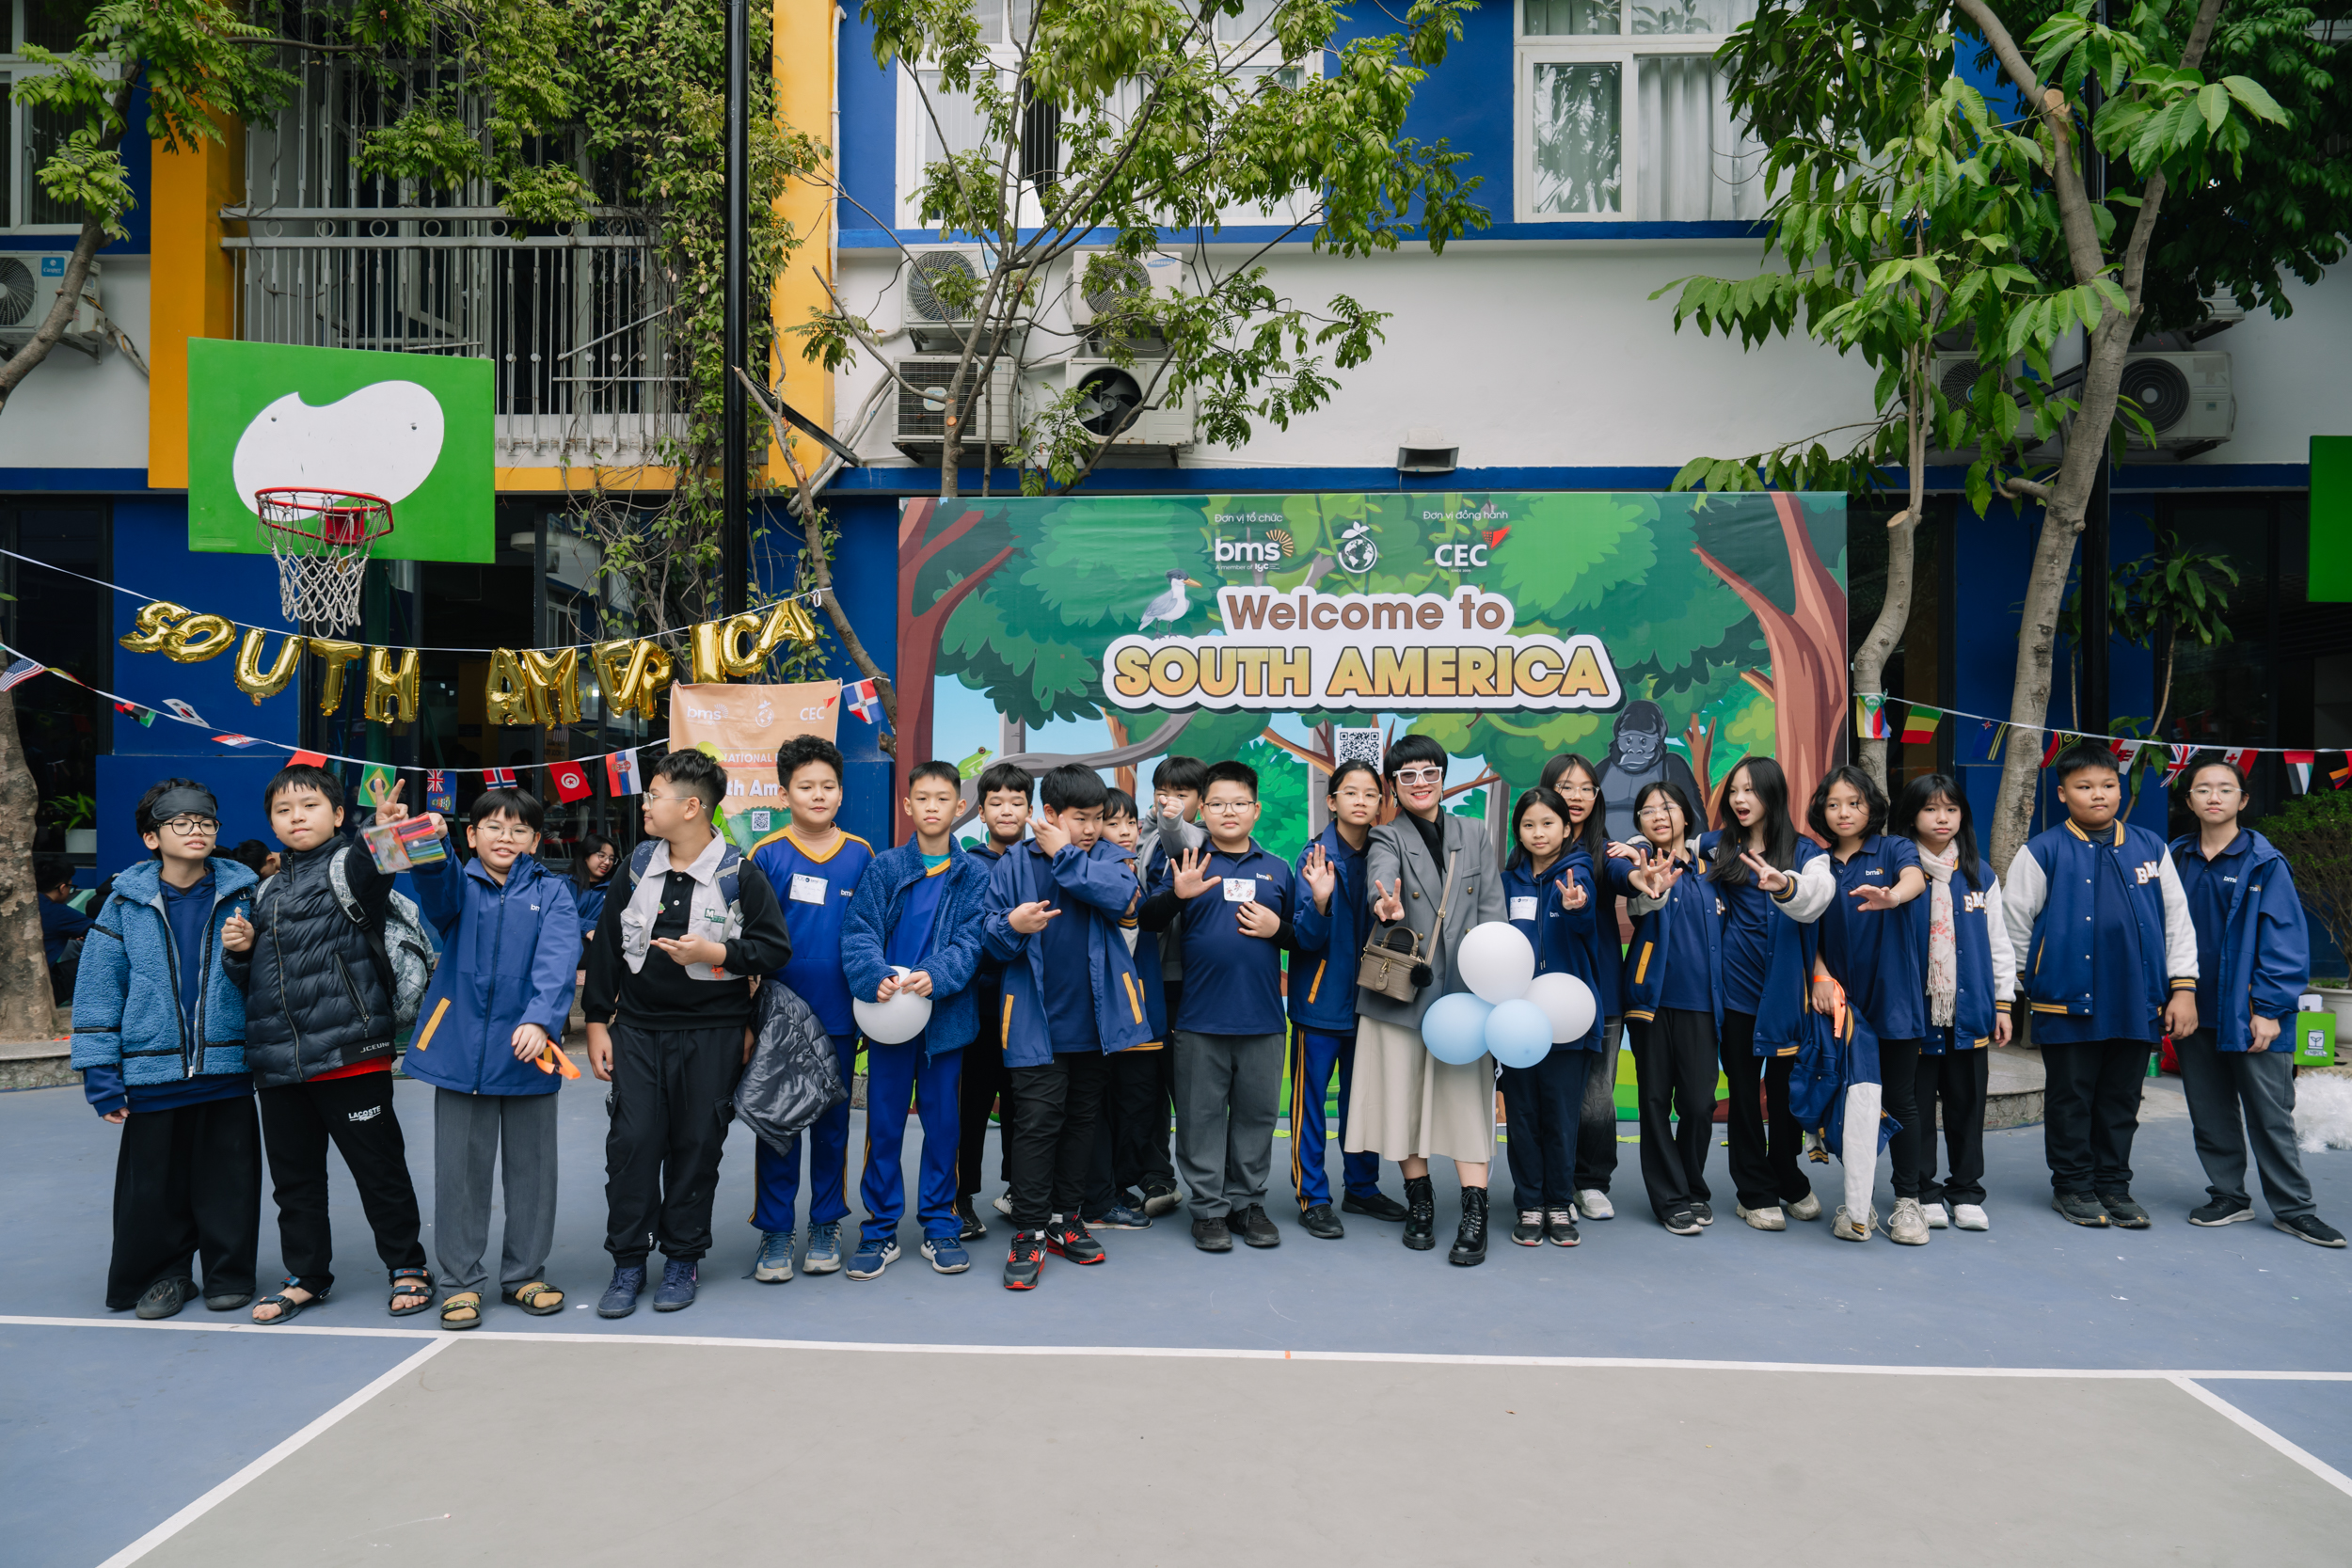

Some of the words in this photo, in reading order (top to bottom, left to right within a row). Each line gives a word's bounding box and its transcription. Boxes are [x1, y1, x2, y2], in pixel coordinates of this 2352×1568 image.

[1215, 514, 1234, 523] Đơn
[1236, 514, 1245, 524] vị
[1247, 512, 1256, 523] tổ
[1258, 514, 1283, 523] chức
[1422, 511, 1443, 520] Đơn
[1446, 511, 1454, 521] vị
[1215, 538, 1280, 562] bms
[1434, 544, 1487, 567] CEC
[1226, 594, 1445, 631] Welcome
[1459, 594, 1505, 630] to
[119, 600, 421, 724] SOUTH
[1114, 644, 1312, 698] SOUTH
[1325, 644, 1611, 698] AMERICA
[687, 705, 722, 721] bms
[800, 706, 825, 721] CEC
[1963, 891, 1987, 914] BM
[348, 1105, 381, 1119] LACOSTE
